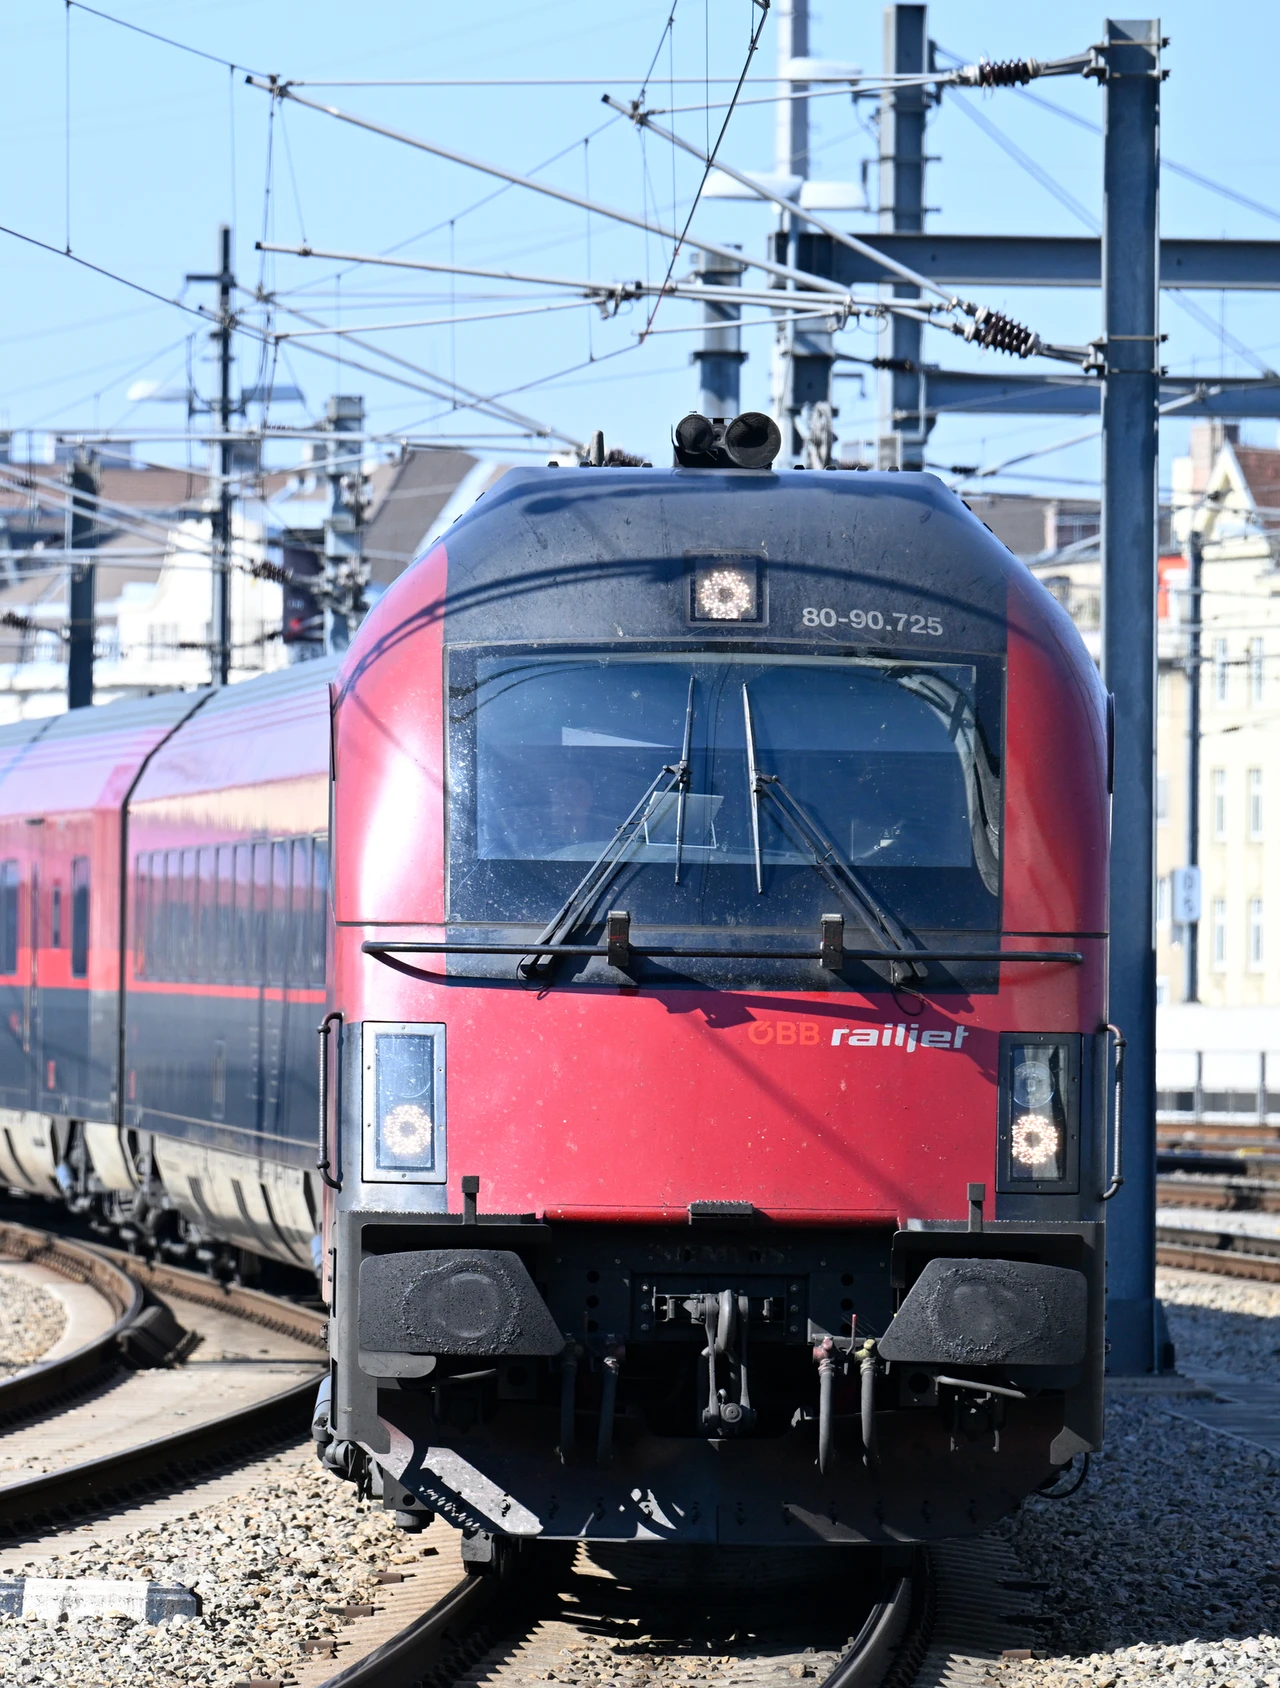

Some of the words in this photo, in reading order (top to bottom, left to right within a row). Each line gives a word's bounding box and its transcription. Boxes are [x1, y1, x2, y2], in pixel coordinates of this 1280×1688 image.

[802, 607, 943, 636] 80-90.725
[748, 1020, 819, 1045] ÖBB
[830, 1023, 969, 1053] railjet
